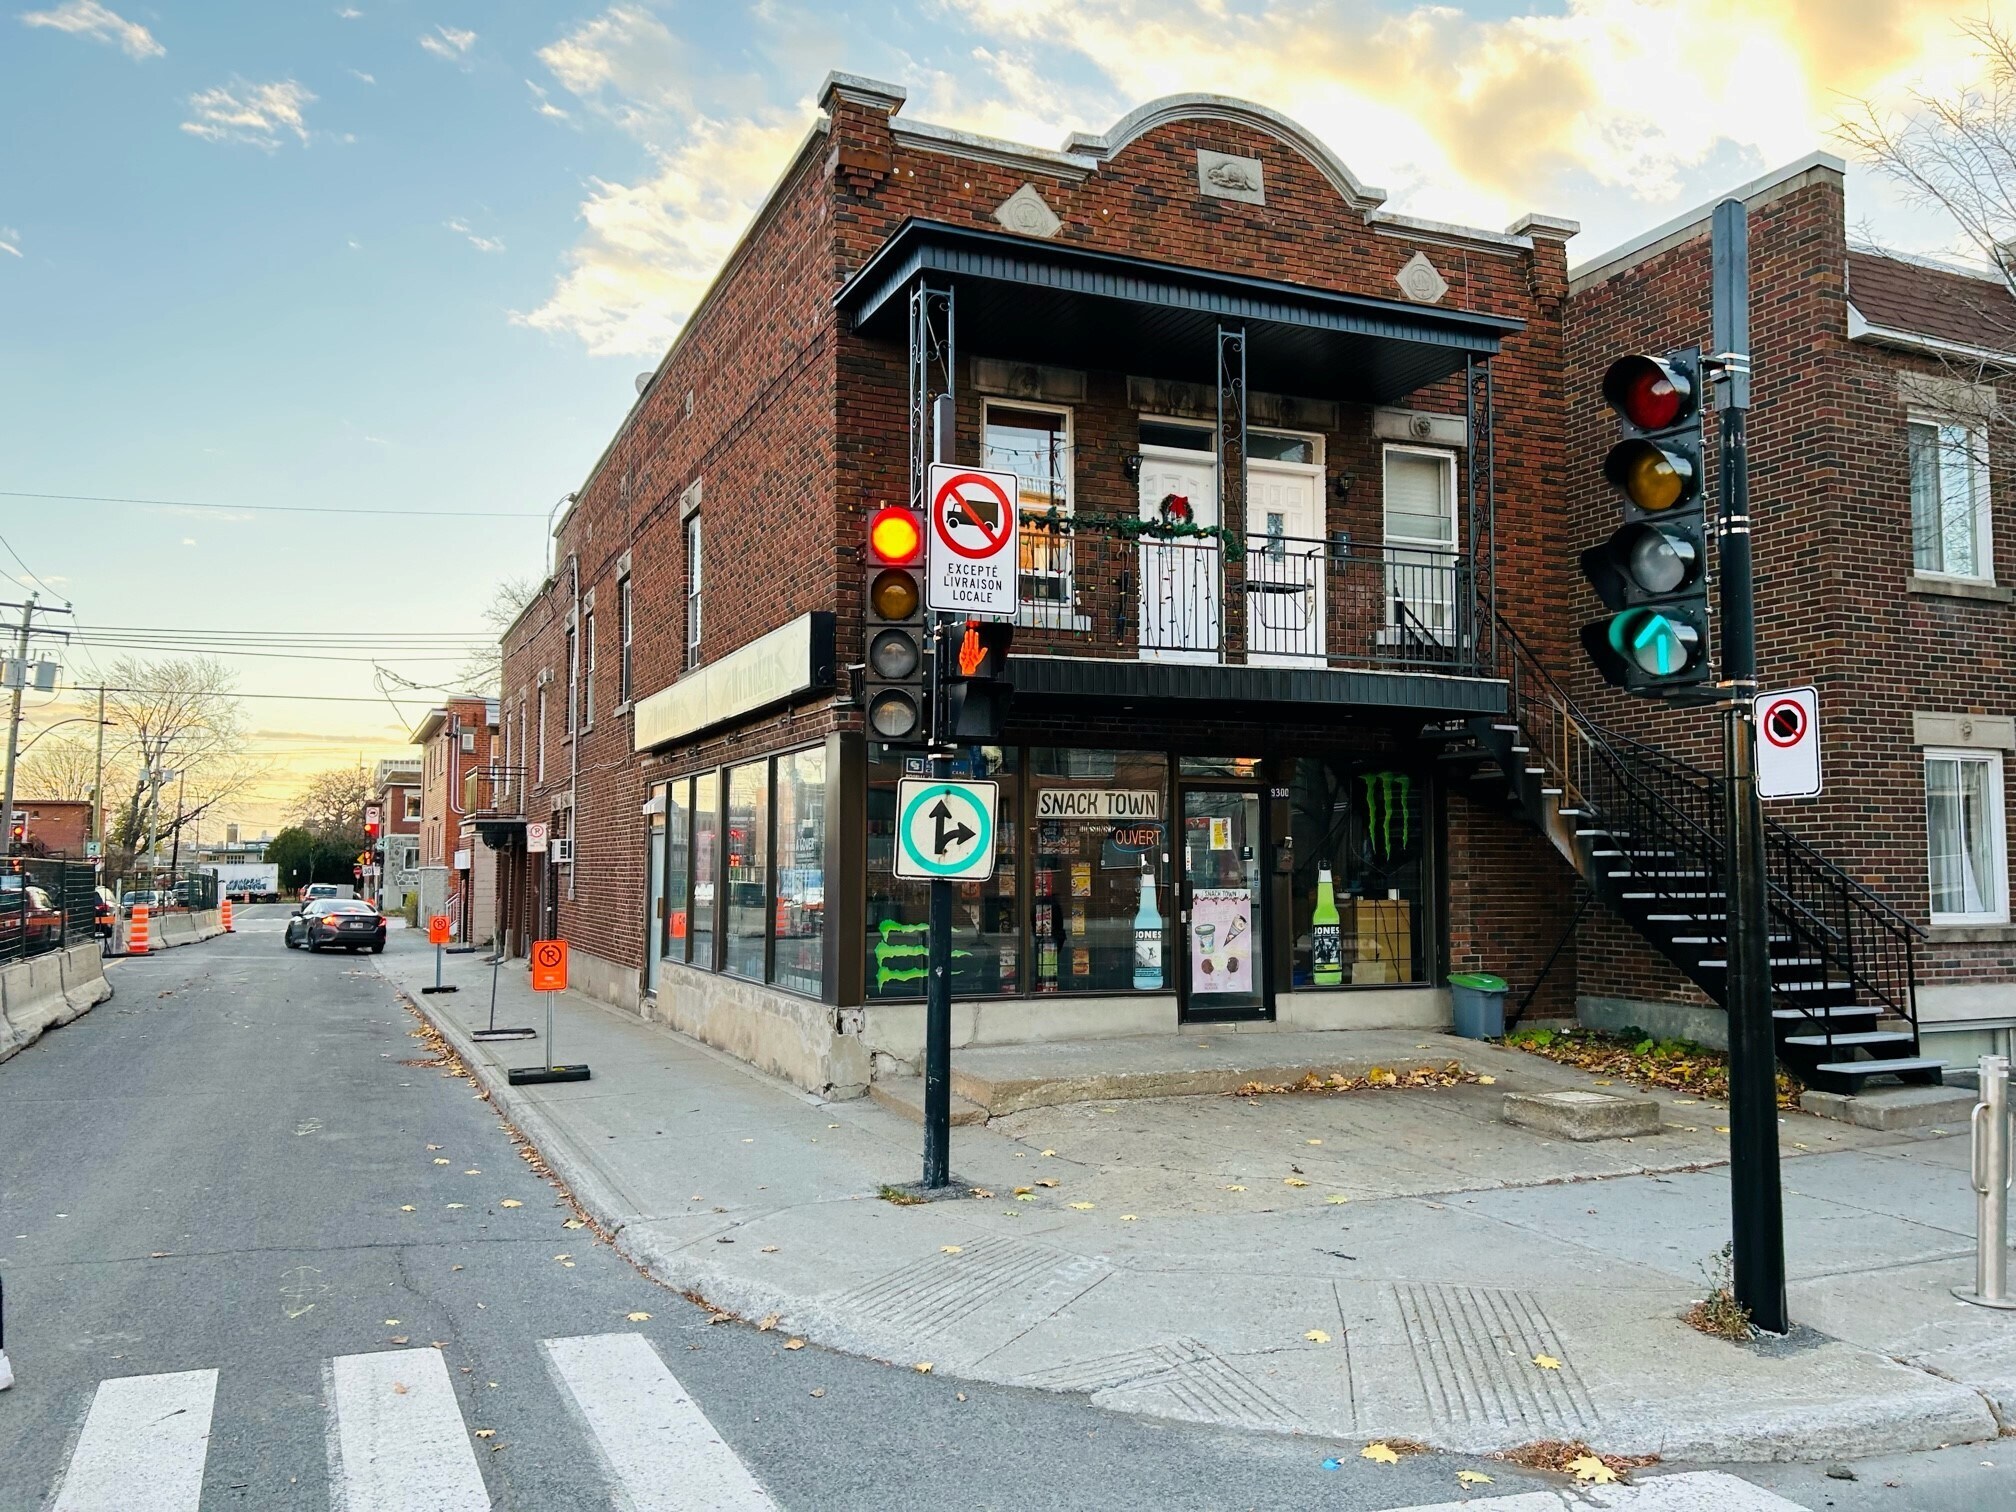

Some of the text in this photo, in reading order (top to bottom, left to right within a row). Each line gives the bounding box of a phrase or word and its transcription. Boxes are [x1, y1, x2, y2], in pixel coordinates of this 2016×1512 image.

[948, 563, 998, 578] EXCEPTÉ
[943, 576, 1002, 591] LIVRAISON
[952, 590, 992, 603] LOCALE
[1270, 788, 1289, 797] 9300
[1040, 792, 1156, 816] SNACK TOWN
[1115, 829, 1162, 846] OUVERT
[363, 867, 372, 875] 30
[1135, 930, 1162, 939] JONES
[1314, 926, 1340, 935] JONES
